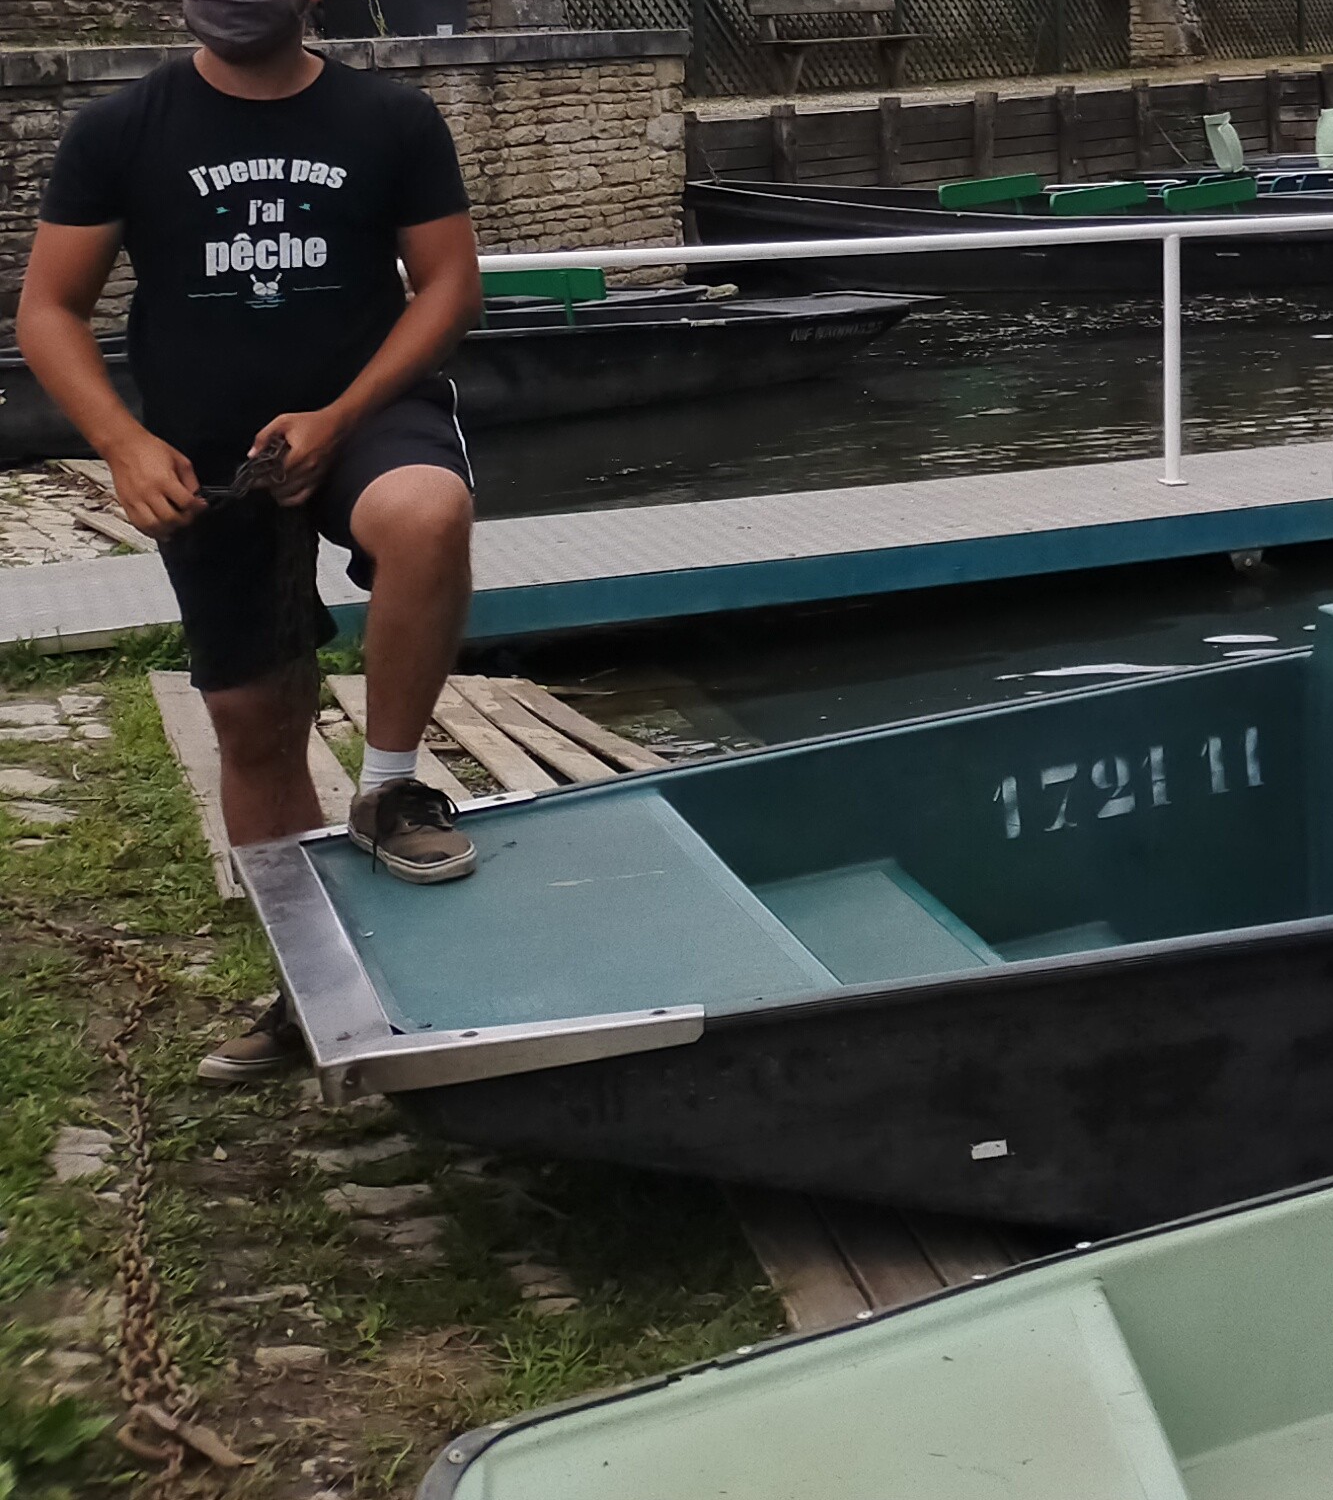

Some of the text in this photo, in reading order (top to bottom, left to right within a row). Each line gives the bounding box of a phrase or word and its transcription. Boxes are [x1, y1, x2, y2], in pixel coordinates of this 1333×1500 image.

[188, 158, 347, 197] j'peux pas
[248, 198, 285, 226] j'ai
[205, 232, 327, 277] pêche
[993, 744, 1172, 839] 1721
